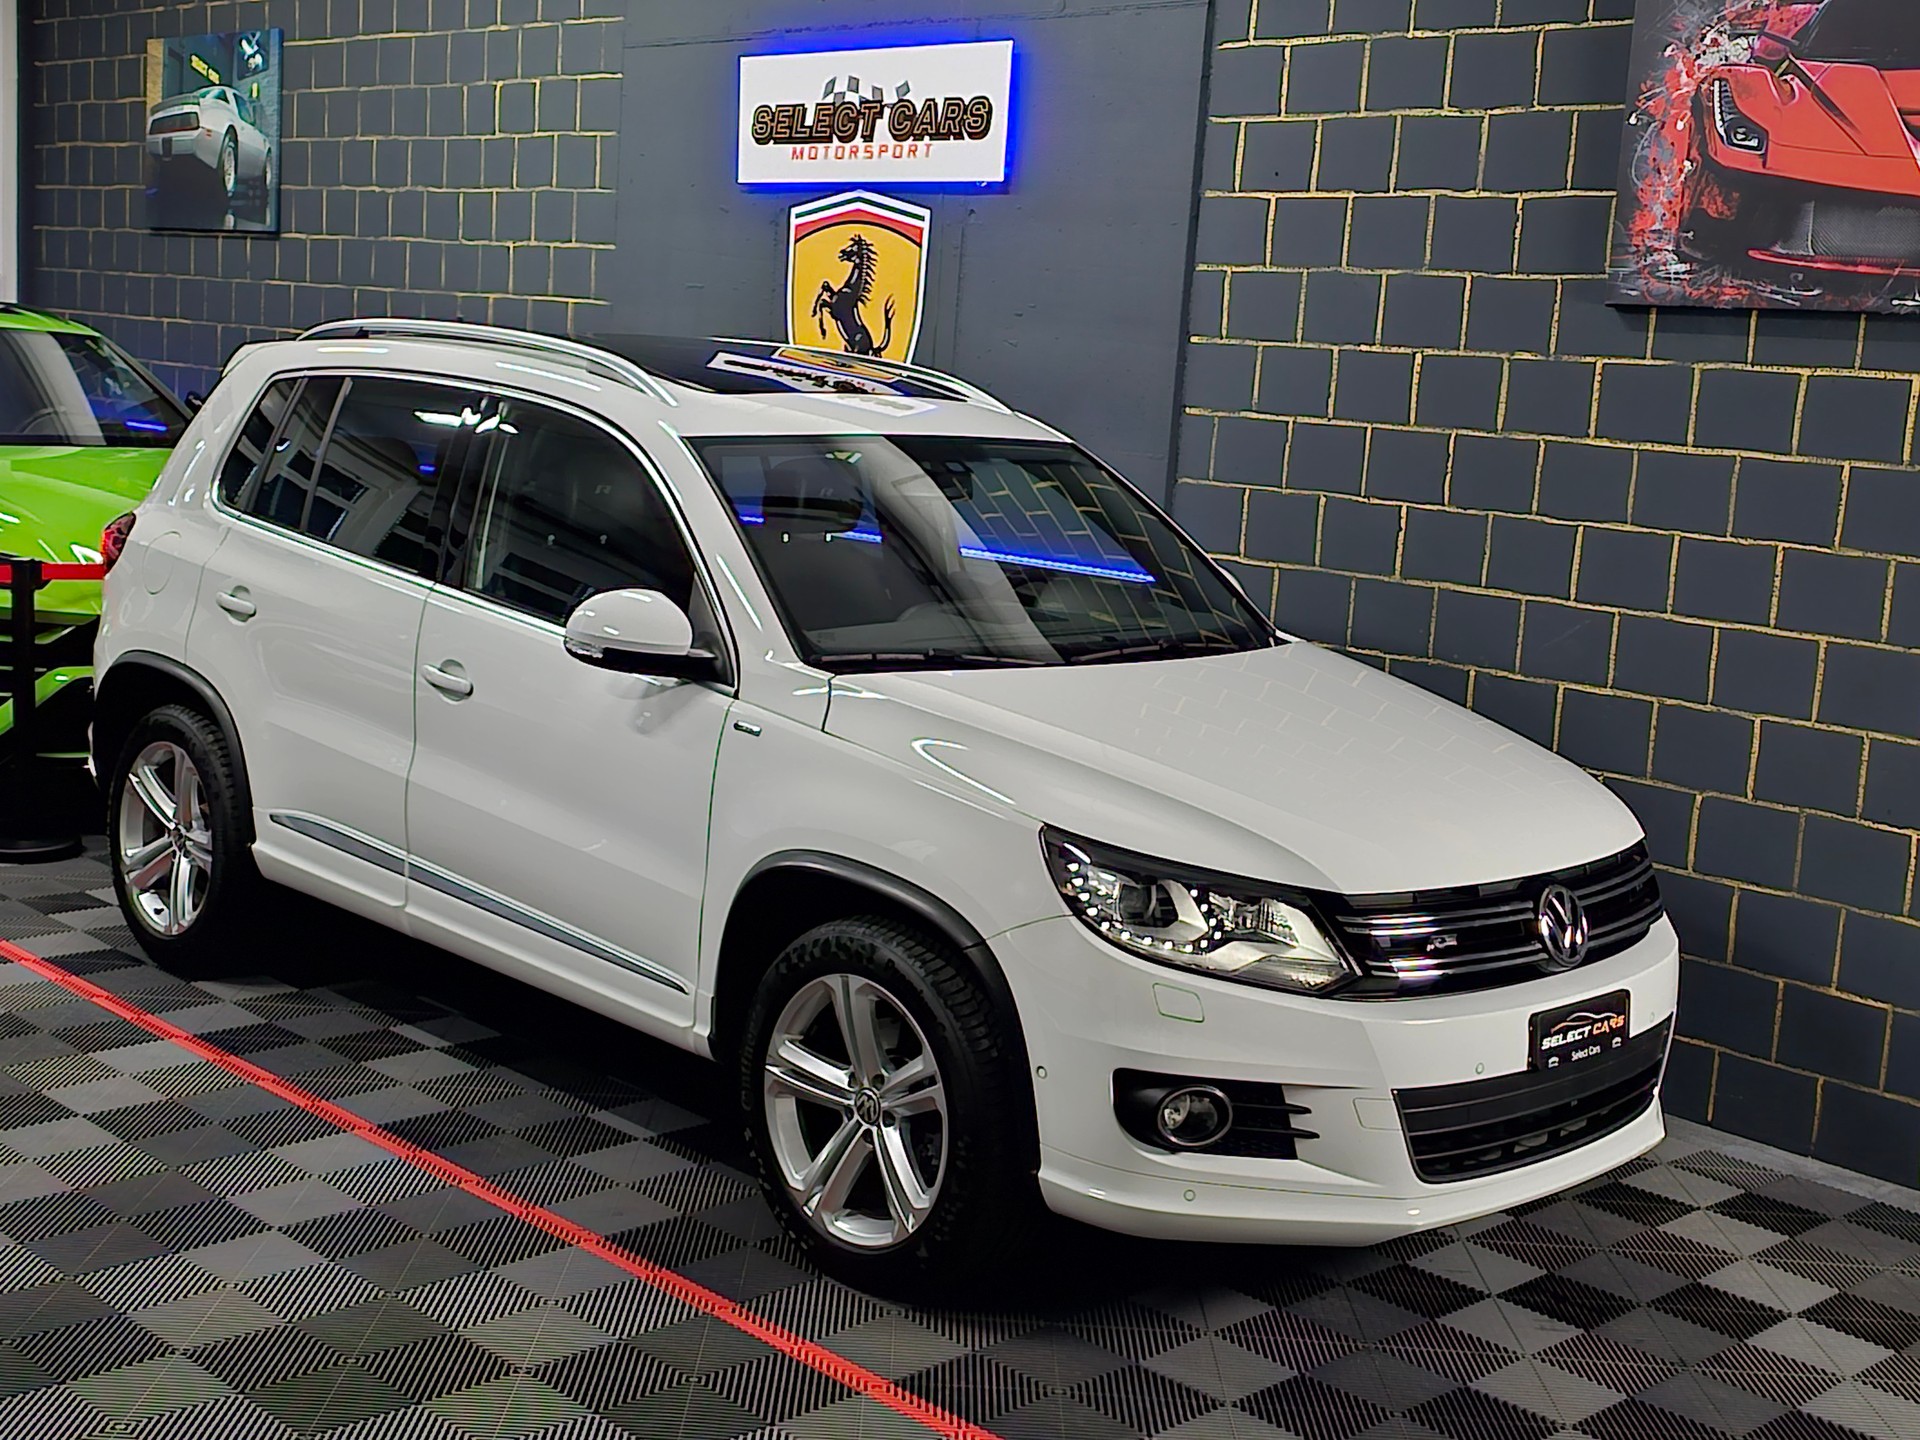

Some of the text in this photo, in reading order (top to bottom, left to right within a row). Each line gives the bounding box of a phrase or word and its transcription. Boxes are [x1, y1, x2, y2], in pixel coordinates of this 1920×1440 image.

[751, 95, 994, 145] SELECT CARS
[791, 143, 933, 160] MOTORSPORT
[1541, 1015, 1625, 1050] SELECT CARS
